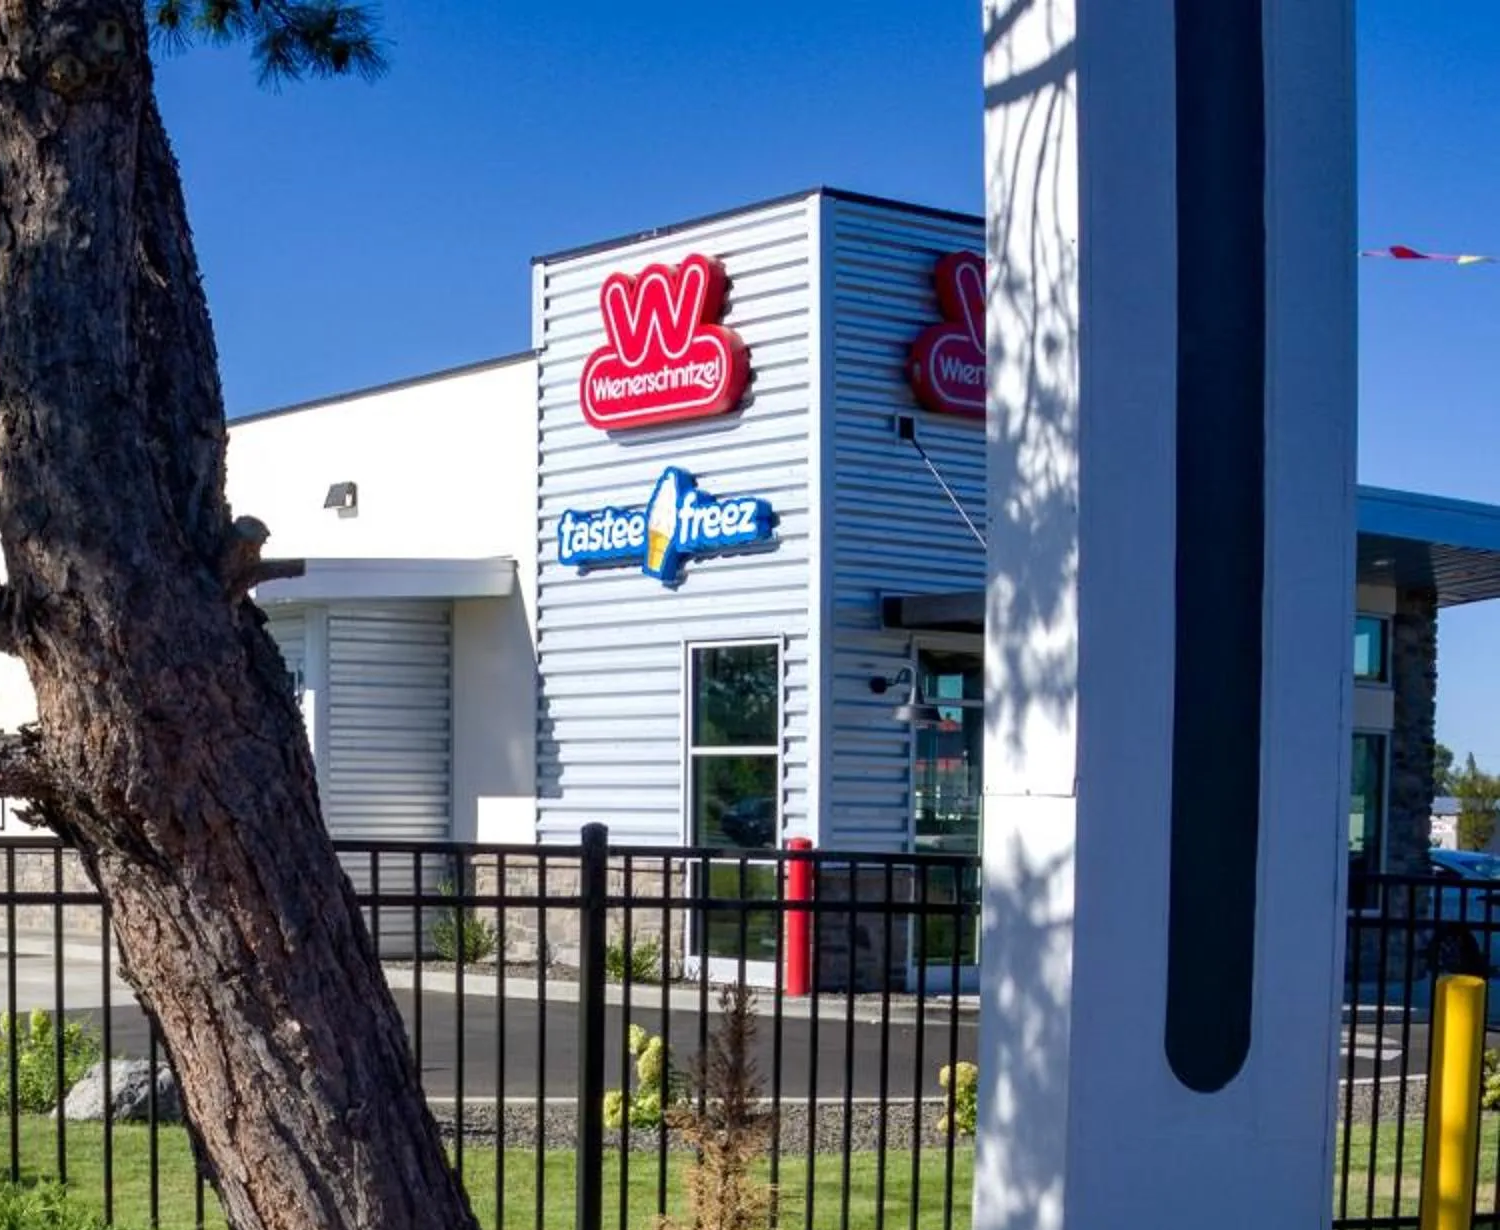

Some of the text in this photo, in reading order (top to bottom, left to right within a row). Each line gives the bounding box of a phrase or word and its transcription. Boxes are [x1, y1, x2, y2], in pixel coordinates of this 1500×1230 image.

[605, 264, 705, 368] W
[592, 355, 721, 401] Wienerschnitzel
[561, 491, 757, 558] tastee freez
